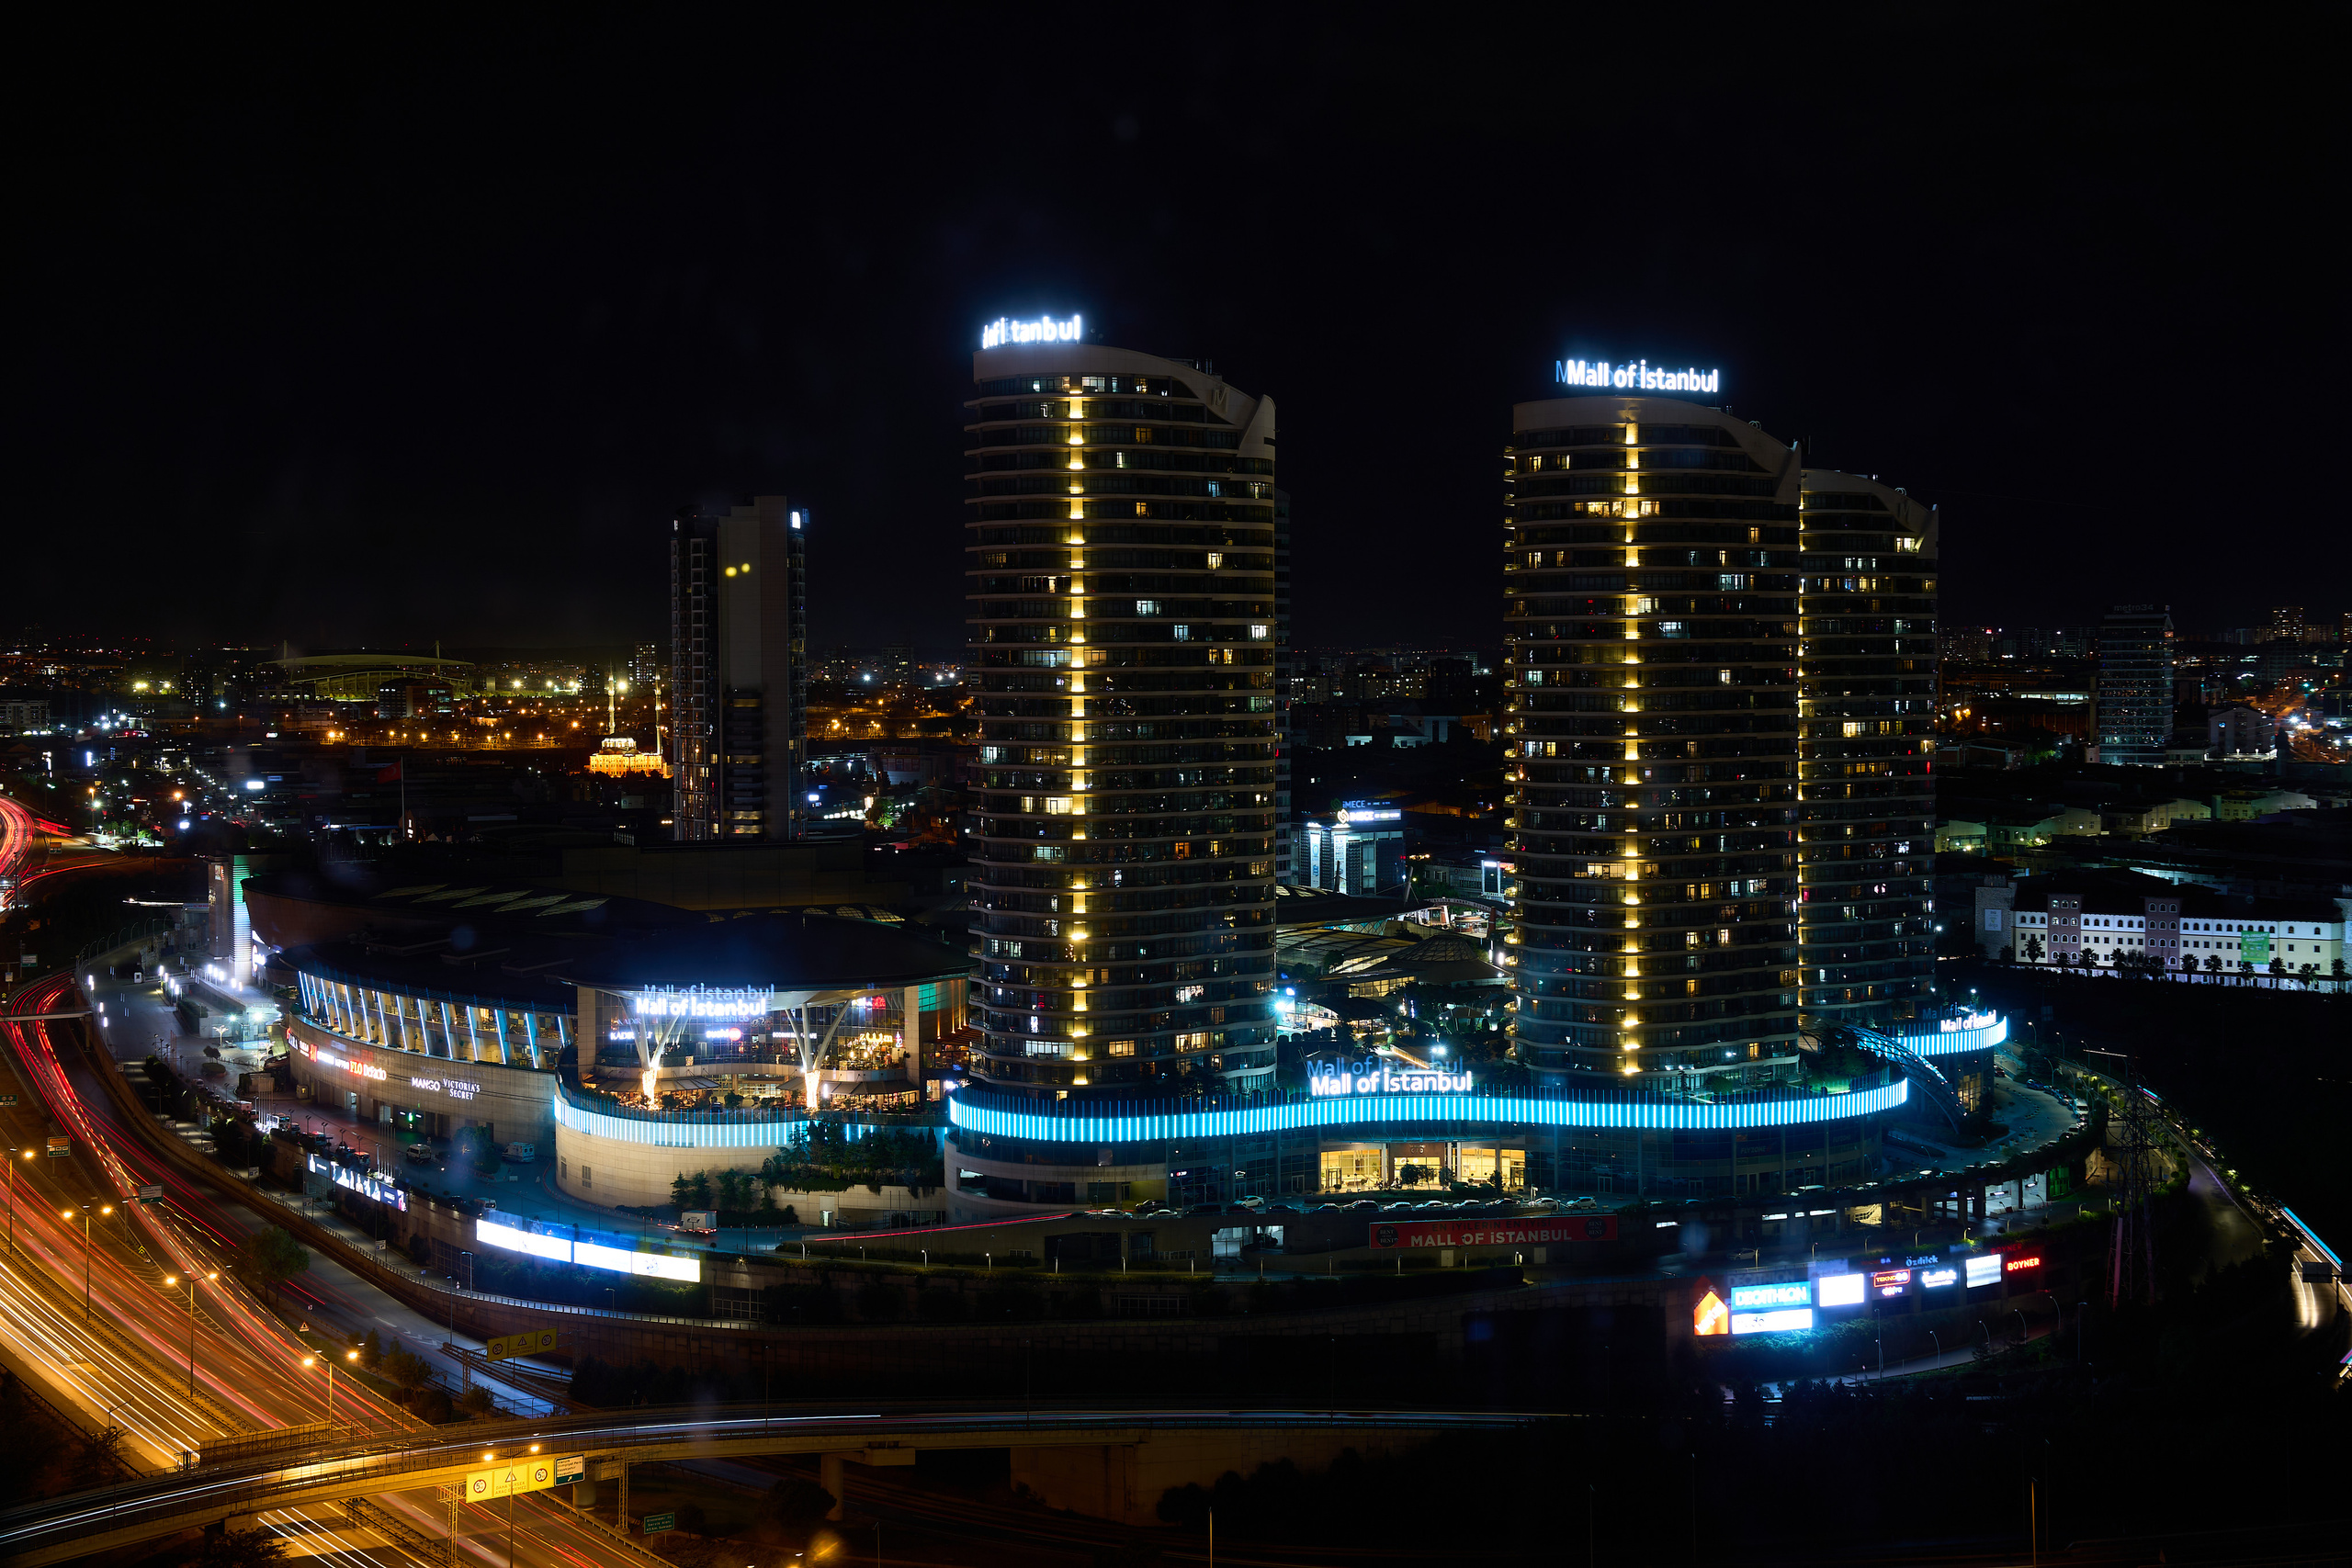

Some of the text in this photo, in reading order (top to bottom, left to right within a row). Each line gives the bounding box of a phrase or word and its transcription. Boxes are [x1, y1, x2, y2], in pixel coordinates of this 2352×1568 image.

[1567, 359, 1610, 387] Mall
[1614, 364, 1636, 388] of
[637, 998, 667, 1015] Mall
[670, 998, 689, 1016] of
[350, 1060, 363, 1076] FLO
[412, 1077, 441, 1091] MANGO
[443, 1077, 481, 1093] VICTORIA'S
[1311, 1072, 1351, 1096] Mall
[1357, 1071, 1380, 1092] of
[449, 1088, 473, 1100] SECRET
[1432, 1224, 1447, 1232] EN
[1506, 1220, 1521, 1228] EN
[1411, 1234, 1456, 1247] MALL
[1462, 1233, 1485, 1245] OF
[2007, 1258, 2040, 1271] BOYNER
